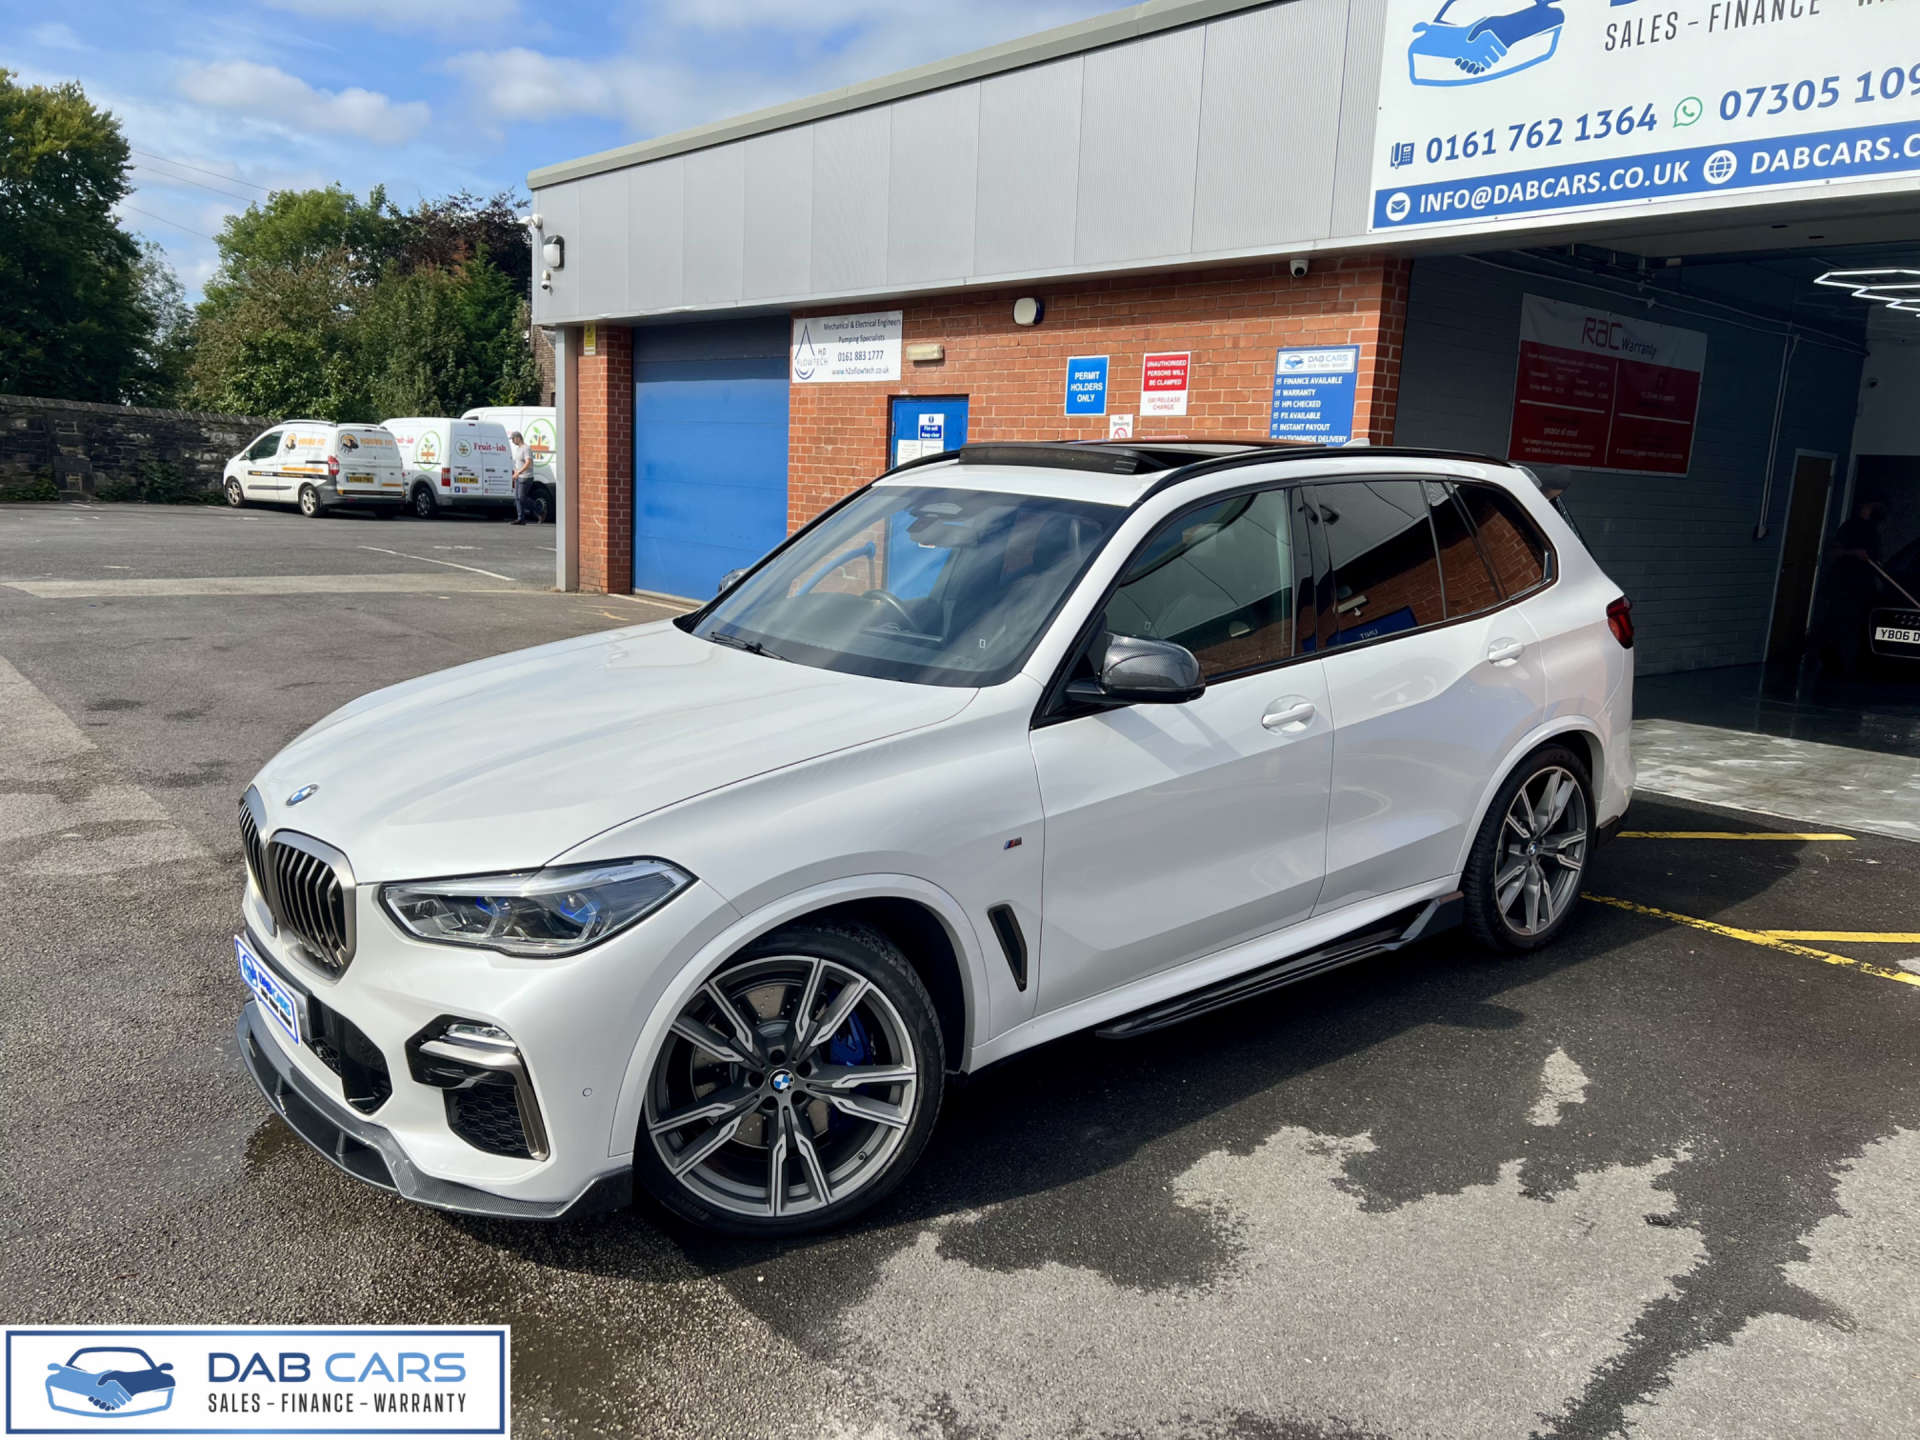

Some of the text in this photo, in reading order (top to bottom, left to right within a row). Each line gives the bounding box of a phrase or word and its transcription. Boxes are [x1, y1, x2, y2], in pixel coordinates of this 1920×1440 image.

[1605, 11, 1678, 51] SALES
[1719, 75, 1840, 121] 07305
[1425, 103, 1656, 165] 0161 762 1364
[1419, 160, 1689, 214] INFO@DABCARS.CO.UK
[1621, 336, 1658, 360] Warranty
[838, 351, 853, 362] 0161
[868, 350, 884, 361] 1777
[1074, 371, 1100, 380] PERMIT
[1283, 376, 1343, 385] FINANCE AVAILABLE
[1070, 382, 1103, 392] HOLDERS
[1282, 388, 1317, 397] WARRANTY
[1076, 394, 1096, 403] ONLY
[1279, 423, 1331, 431] INSTANT PAYOUT
